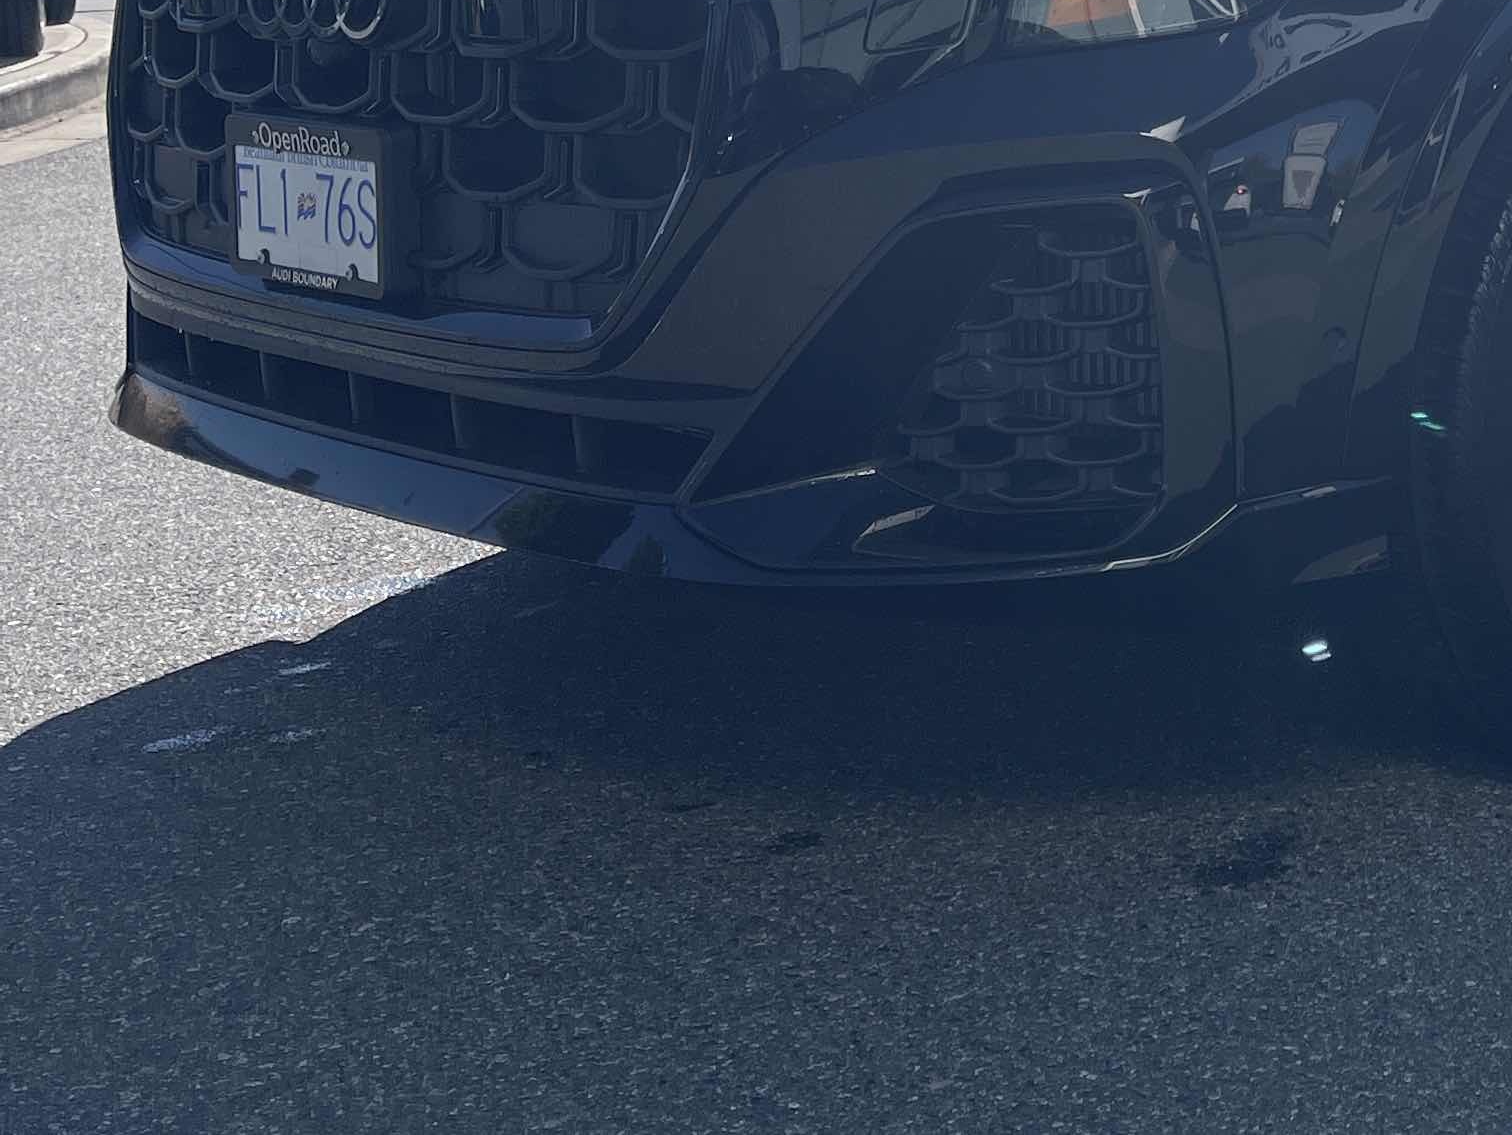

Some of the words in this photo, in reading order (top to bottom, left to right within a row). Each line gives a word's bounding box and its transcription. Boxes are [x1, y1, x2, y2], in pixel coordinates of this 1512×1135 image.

[258, 122, 341, 156] OpenRoad
[315, 172, 376, 249] 76S
[271, 266, 291, 281] AUDI
[292, 271, 338, 289] BOUNDARY
